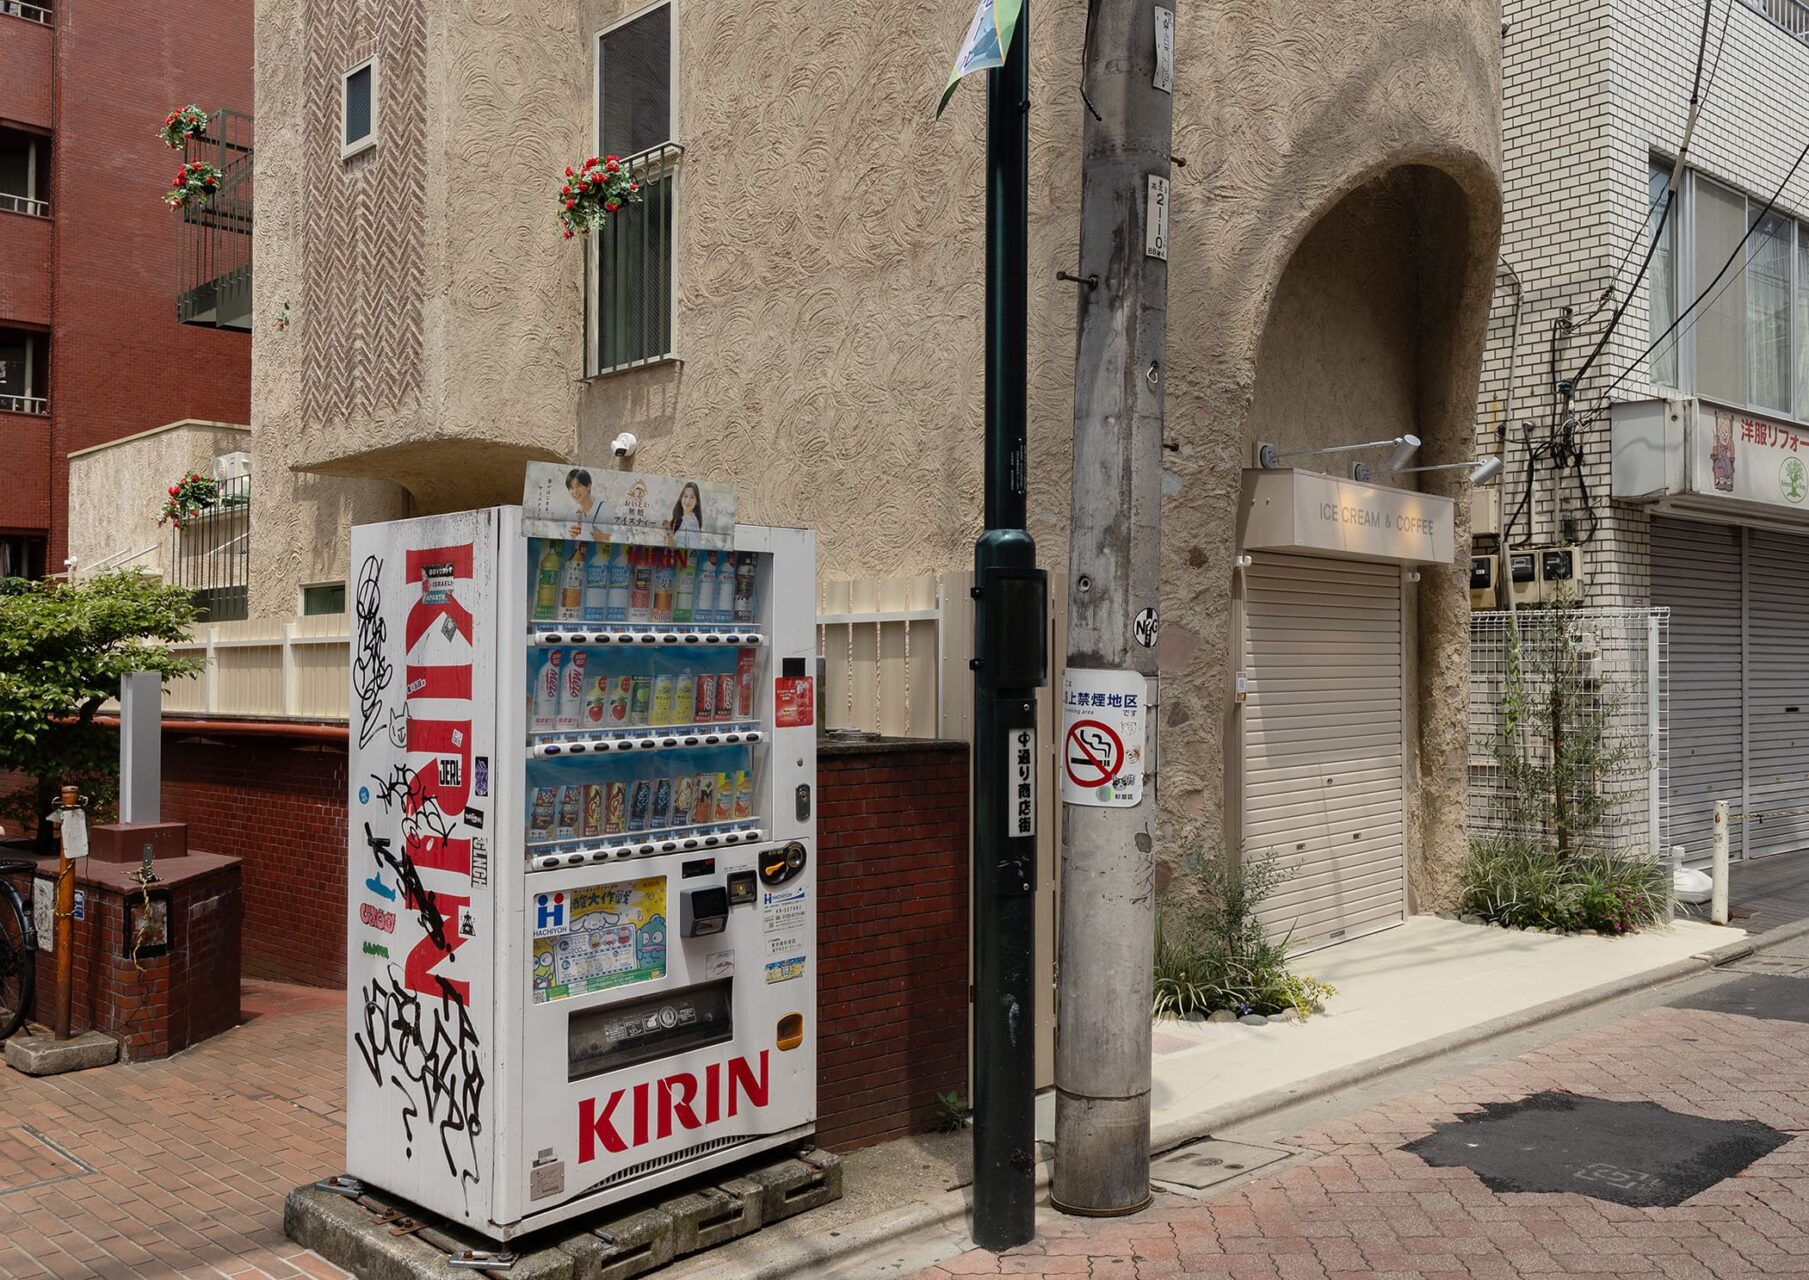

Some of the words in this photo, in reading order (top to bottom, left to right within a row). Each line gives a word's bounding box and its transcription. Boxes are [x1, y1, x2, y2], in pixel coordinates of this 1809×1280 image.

[1741, 418, 1809, 452] 洋服リフォー
[1319, 503, 1339, 522] ICE
[1341, 506, 1380, 529] CREAM
[1384, 514, 1391, 529] &
[1395, 515, 1434, 536] COFFEE
[1122, 709, 1137, 717] です
[1017, 731, 1031, 834] 中通り商店街
[570, 889, 633, 910] 酸大作戦
[533, 926, 568, 937] HACHIYOH
[577, 1049, 770, 1164] KIRIN
